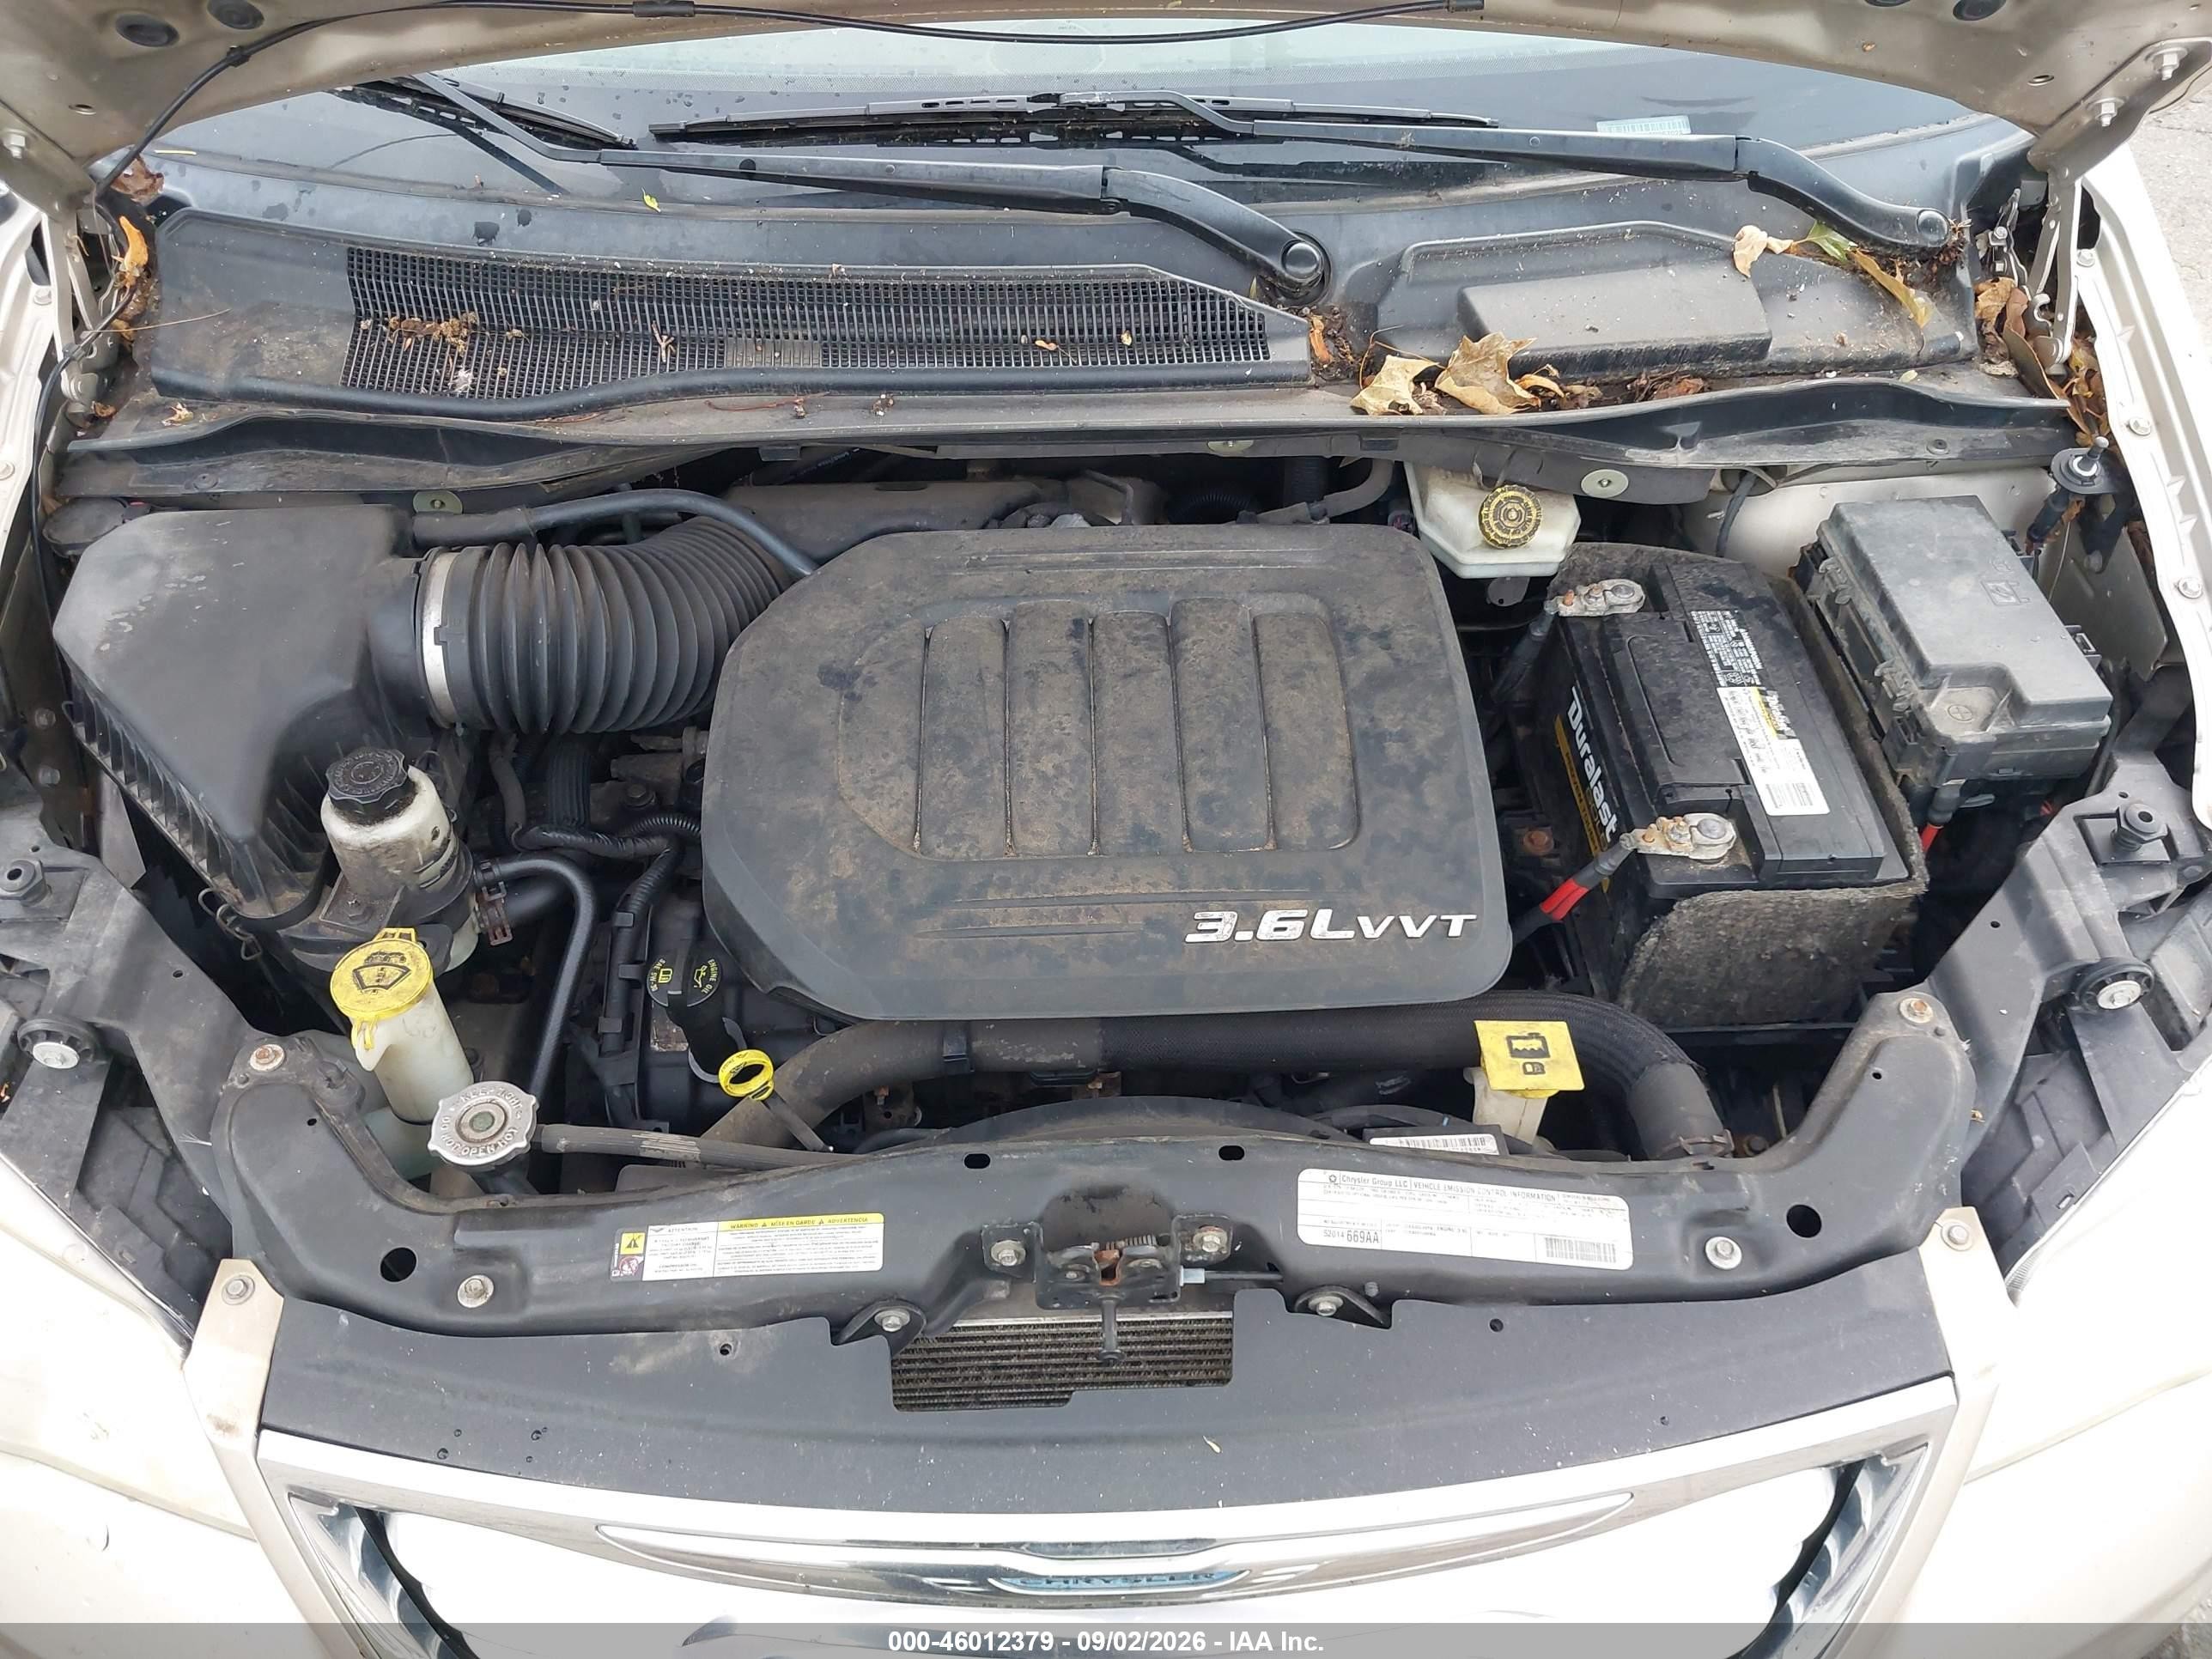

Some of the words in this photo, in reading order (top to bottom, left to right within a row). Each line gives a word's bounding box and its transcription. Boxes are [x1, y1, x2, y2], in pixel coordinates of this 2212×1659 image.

[1567, 685, 1618, 843] Duralast
[653, 958, 666, 970] SAE
[708, 958, 718, 981] ENGINE
[701, 984, 713, 994] OIL
[440, 1115, 451, 1132] DO
[440, 1133, 462, 1152] NOT
[495, 1126, 520, 1150] HOT
[461, 1145, 497, 1157] OPEN
[1340, 1173, 1370, 1185] Chrysler
[1371, 1177, 1393, 1188] Group
[1413, 1182, 1441, 1191] VEHICLE
[1443, 1184, 1475, 1194] EMISSION
[1477, 1187, 1507, 1197] CONTROL
[1510, 1191, 1556, 1202] INFORMATION
